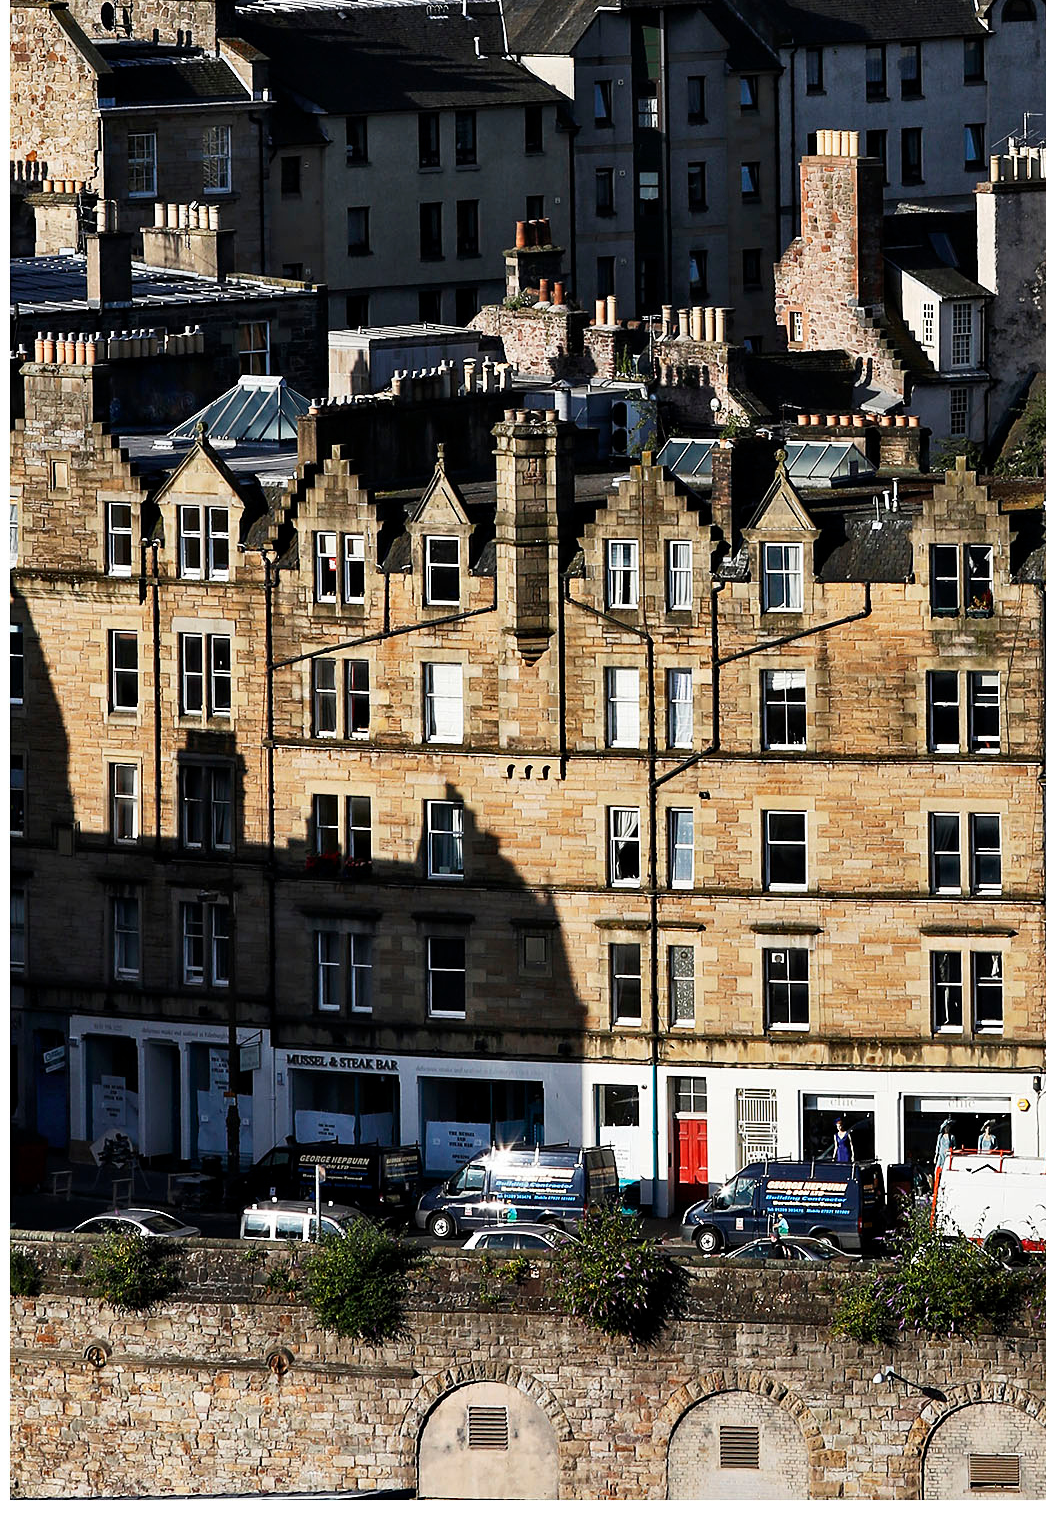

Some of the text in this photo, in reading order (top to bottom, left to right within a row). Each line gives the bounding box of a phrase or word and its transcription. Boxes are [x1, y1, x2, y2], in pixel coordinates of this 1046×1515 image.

[287, 1054, 399, 1071] MUSSEL & STEAK BAR
[299, 1155, 370, 1166] GEORGE HEPBURN
[495, 1180, 528, 1188] Building
[767, 1180, 848, 1192] GEORGE HEPBURN
